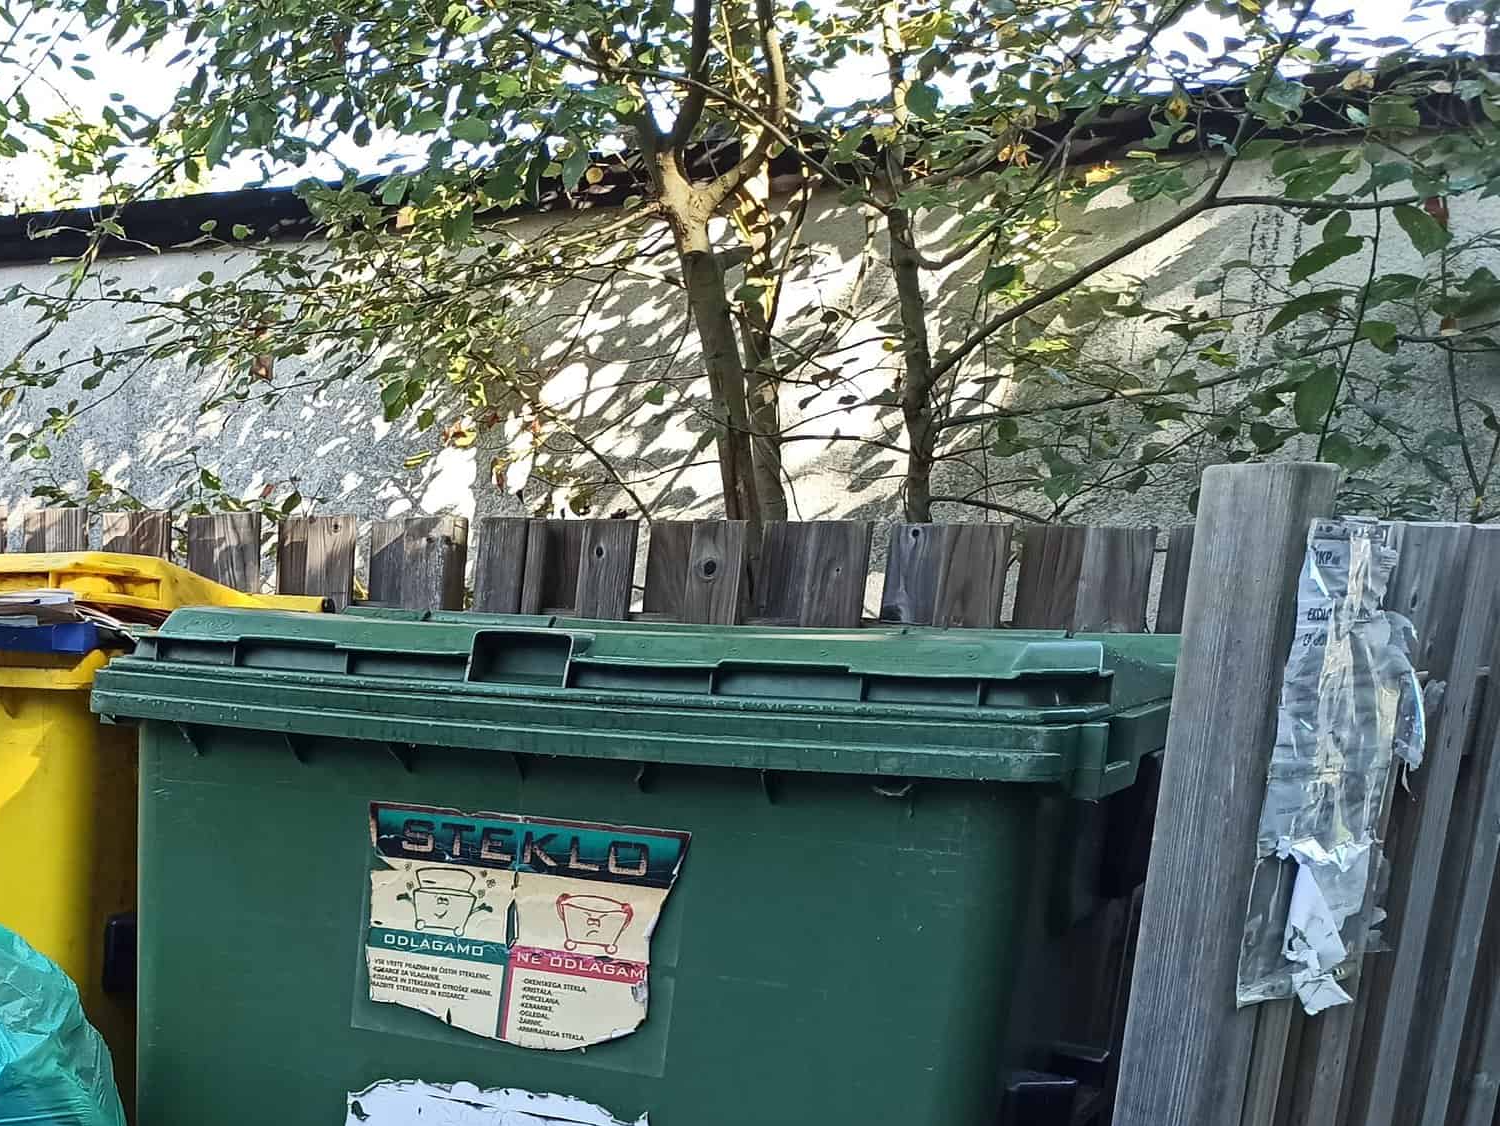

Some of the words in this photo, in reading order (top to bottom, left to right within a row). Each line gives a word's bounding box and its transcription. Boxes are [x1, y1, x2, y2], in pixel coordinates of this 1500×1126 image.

[402, 819, 650, 877] STEKLO
[384, 934, 484, 956] ODLAGAMO
[517, 951, 540, 965] NE
[550, 955, 645, 978] ODLAGAM
